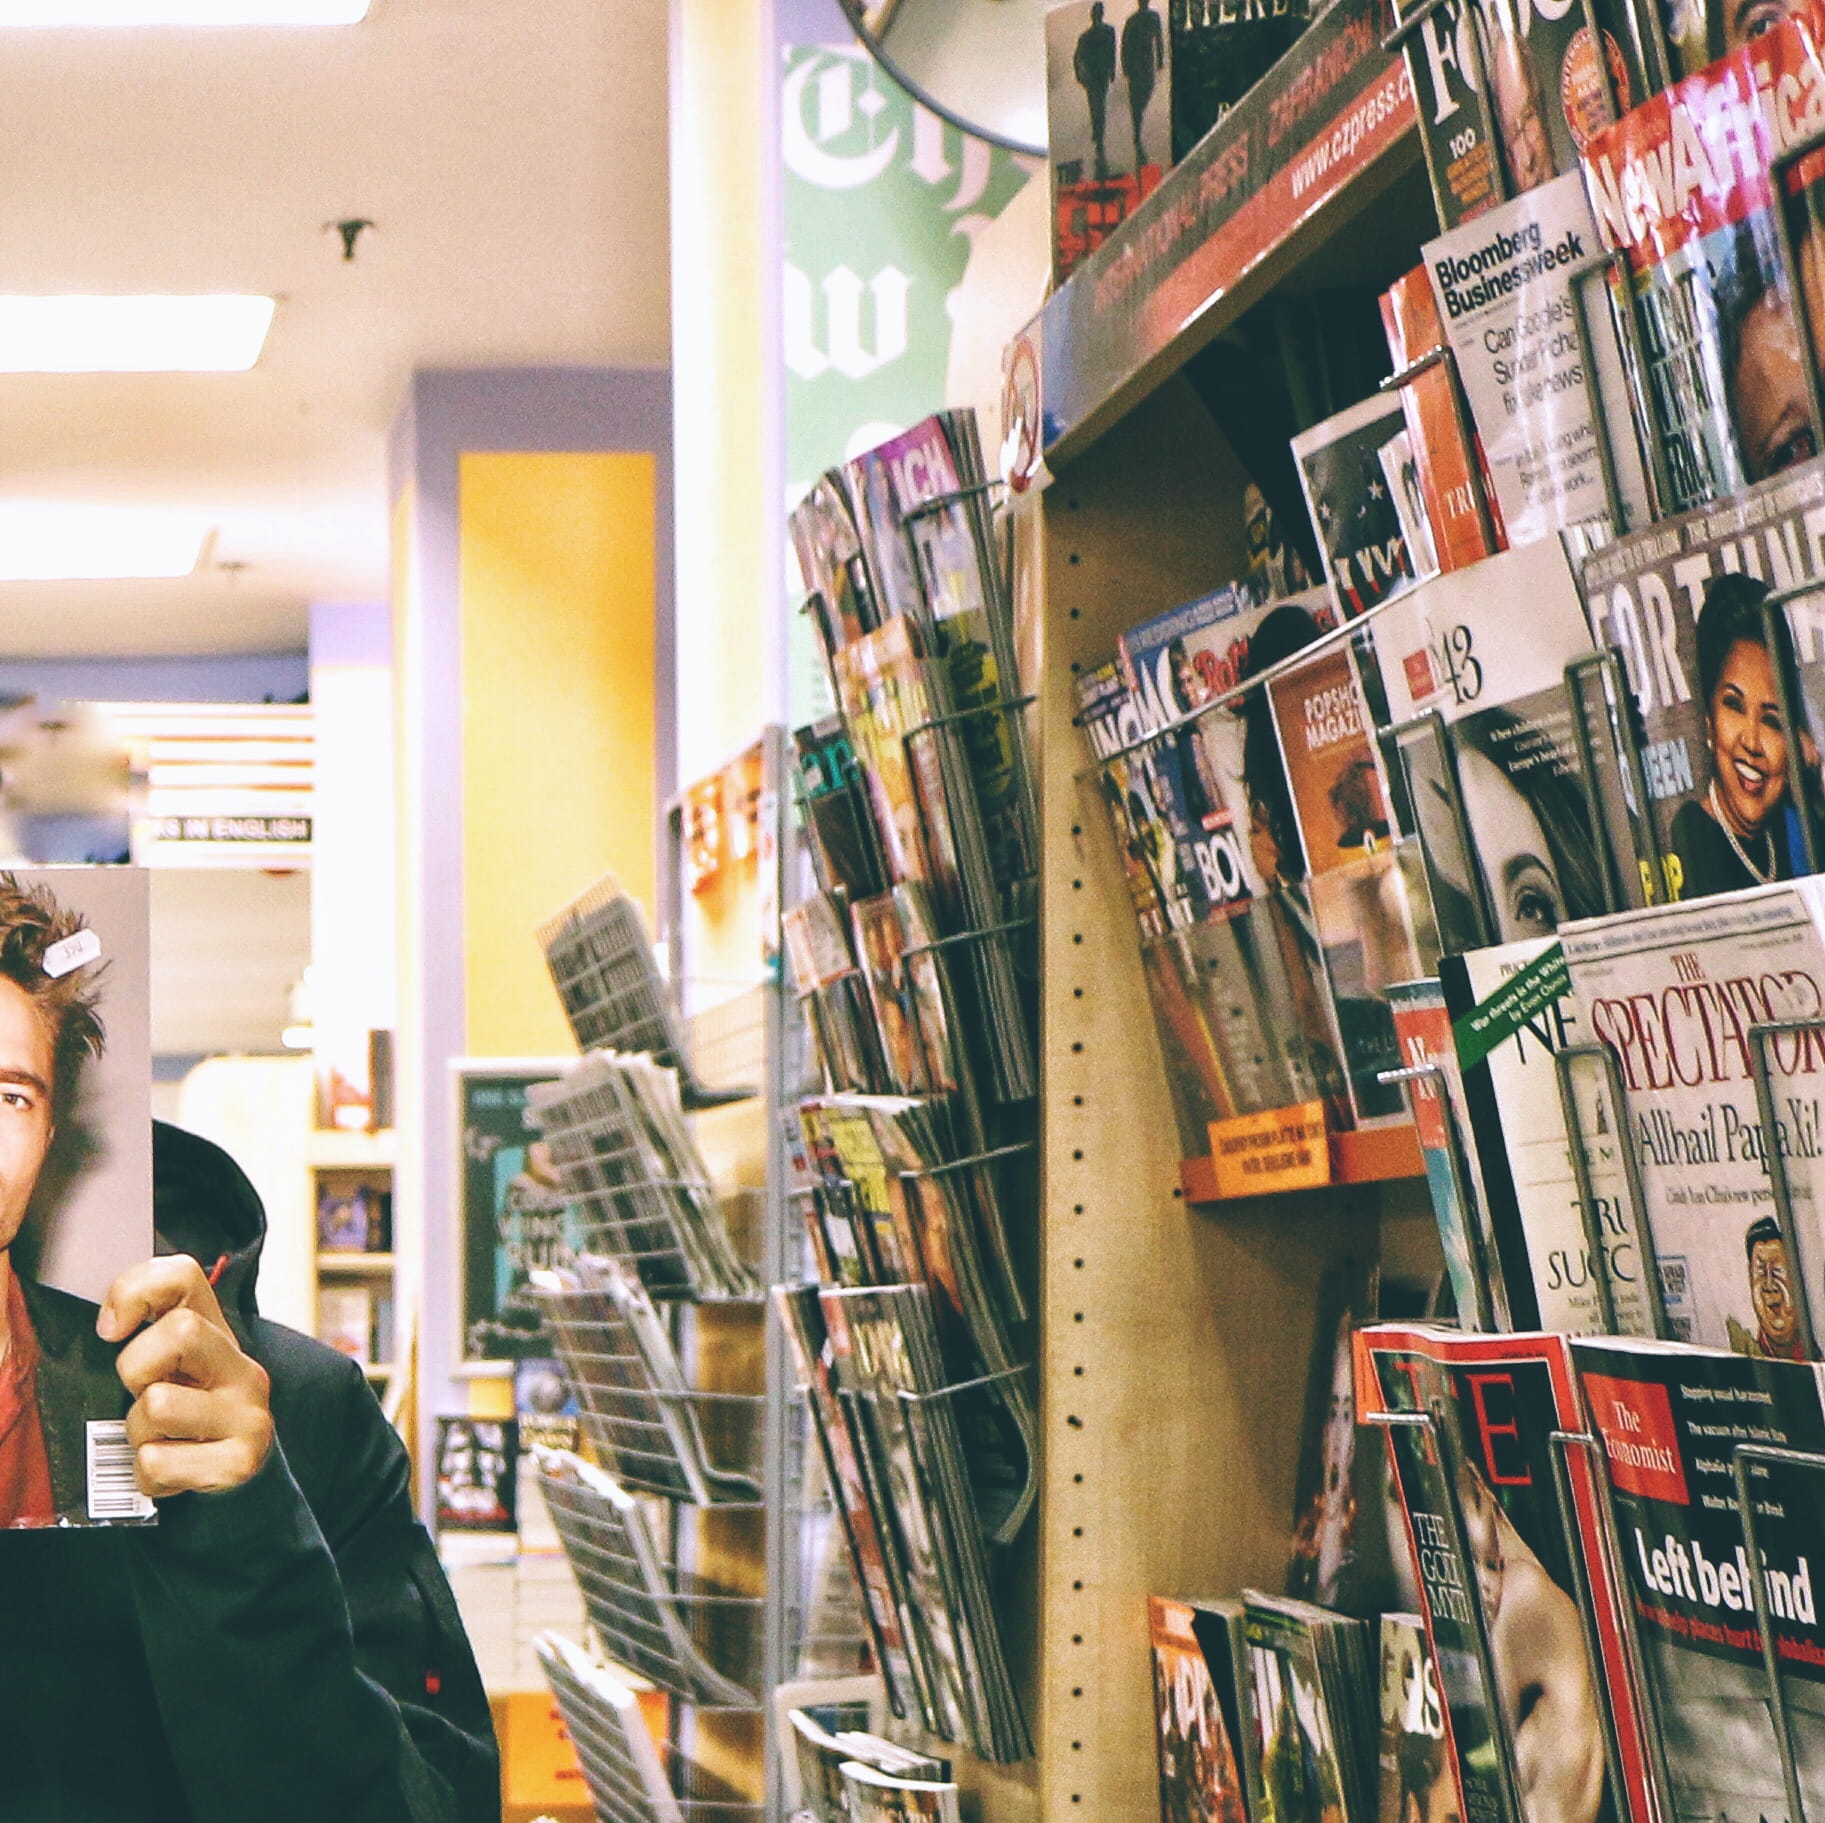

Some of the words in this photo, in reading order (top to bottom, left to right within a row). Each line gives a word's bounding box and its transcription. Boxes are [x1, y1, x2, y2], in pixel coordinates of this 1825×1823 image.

[1435, 222, 1542, 290] Bloomberg
[1444, 231, 1585, 319] Businessweek
[1303, 683, 1360, 724] POPSHO
[1305, 708, 1364, 752] MAGAZI
[212, 819, 307, 839] ENGLISH
[1611, 1400, 1640, 1433] The
[1601, 1428, 1676, 1474] Economist
[1412, 1511, 1450, 1549] THE
[1634, 1527, 1697, 1602] Left
